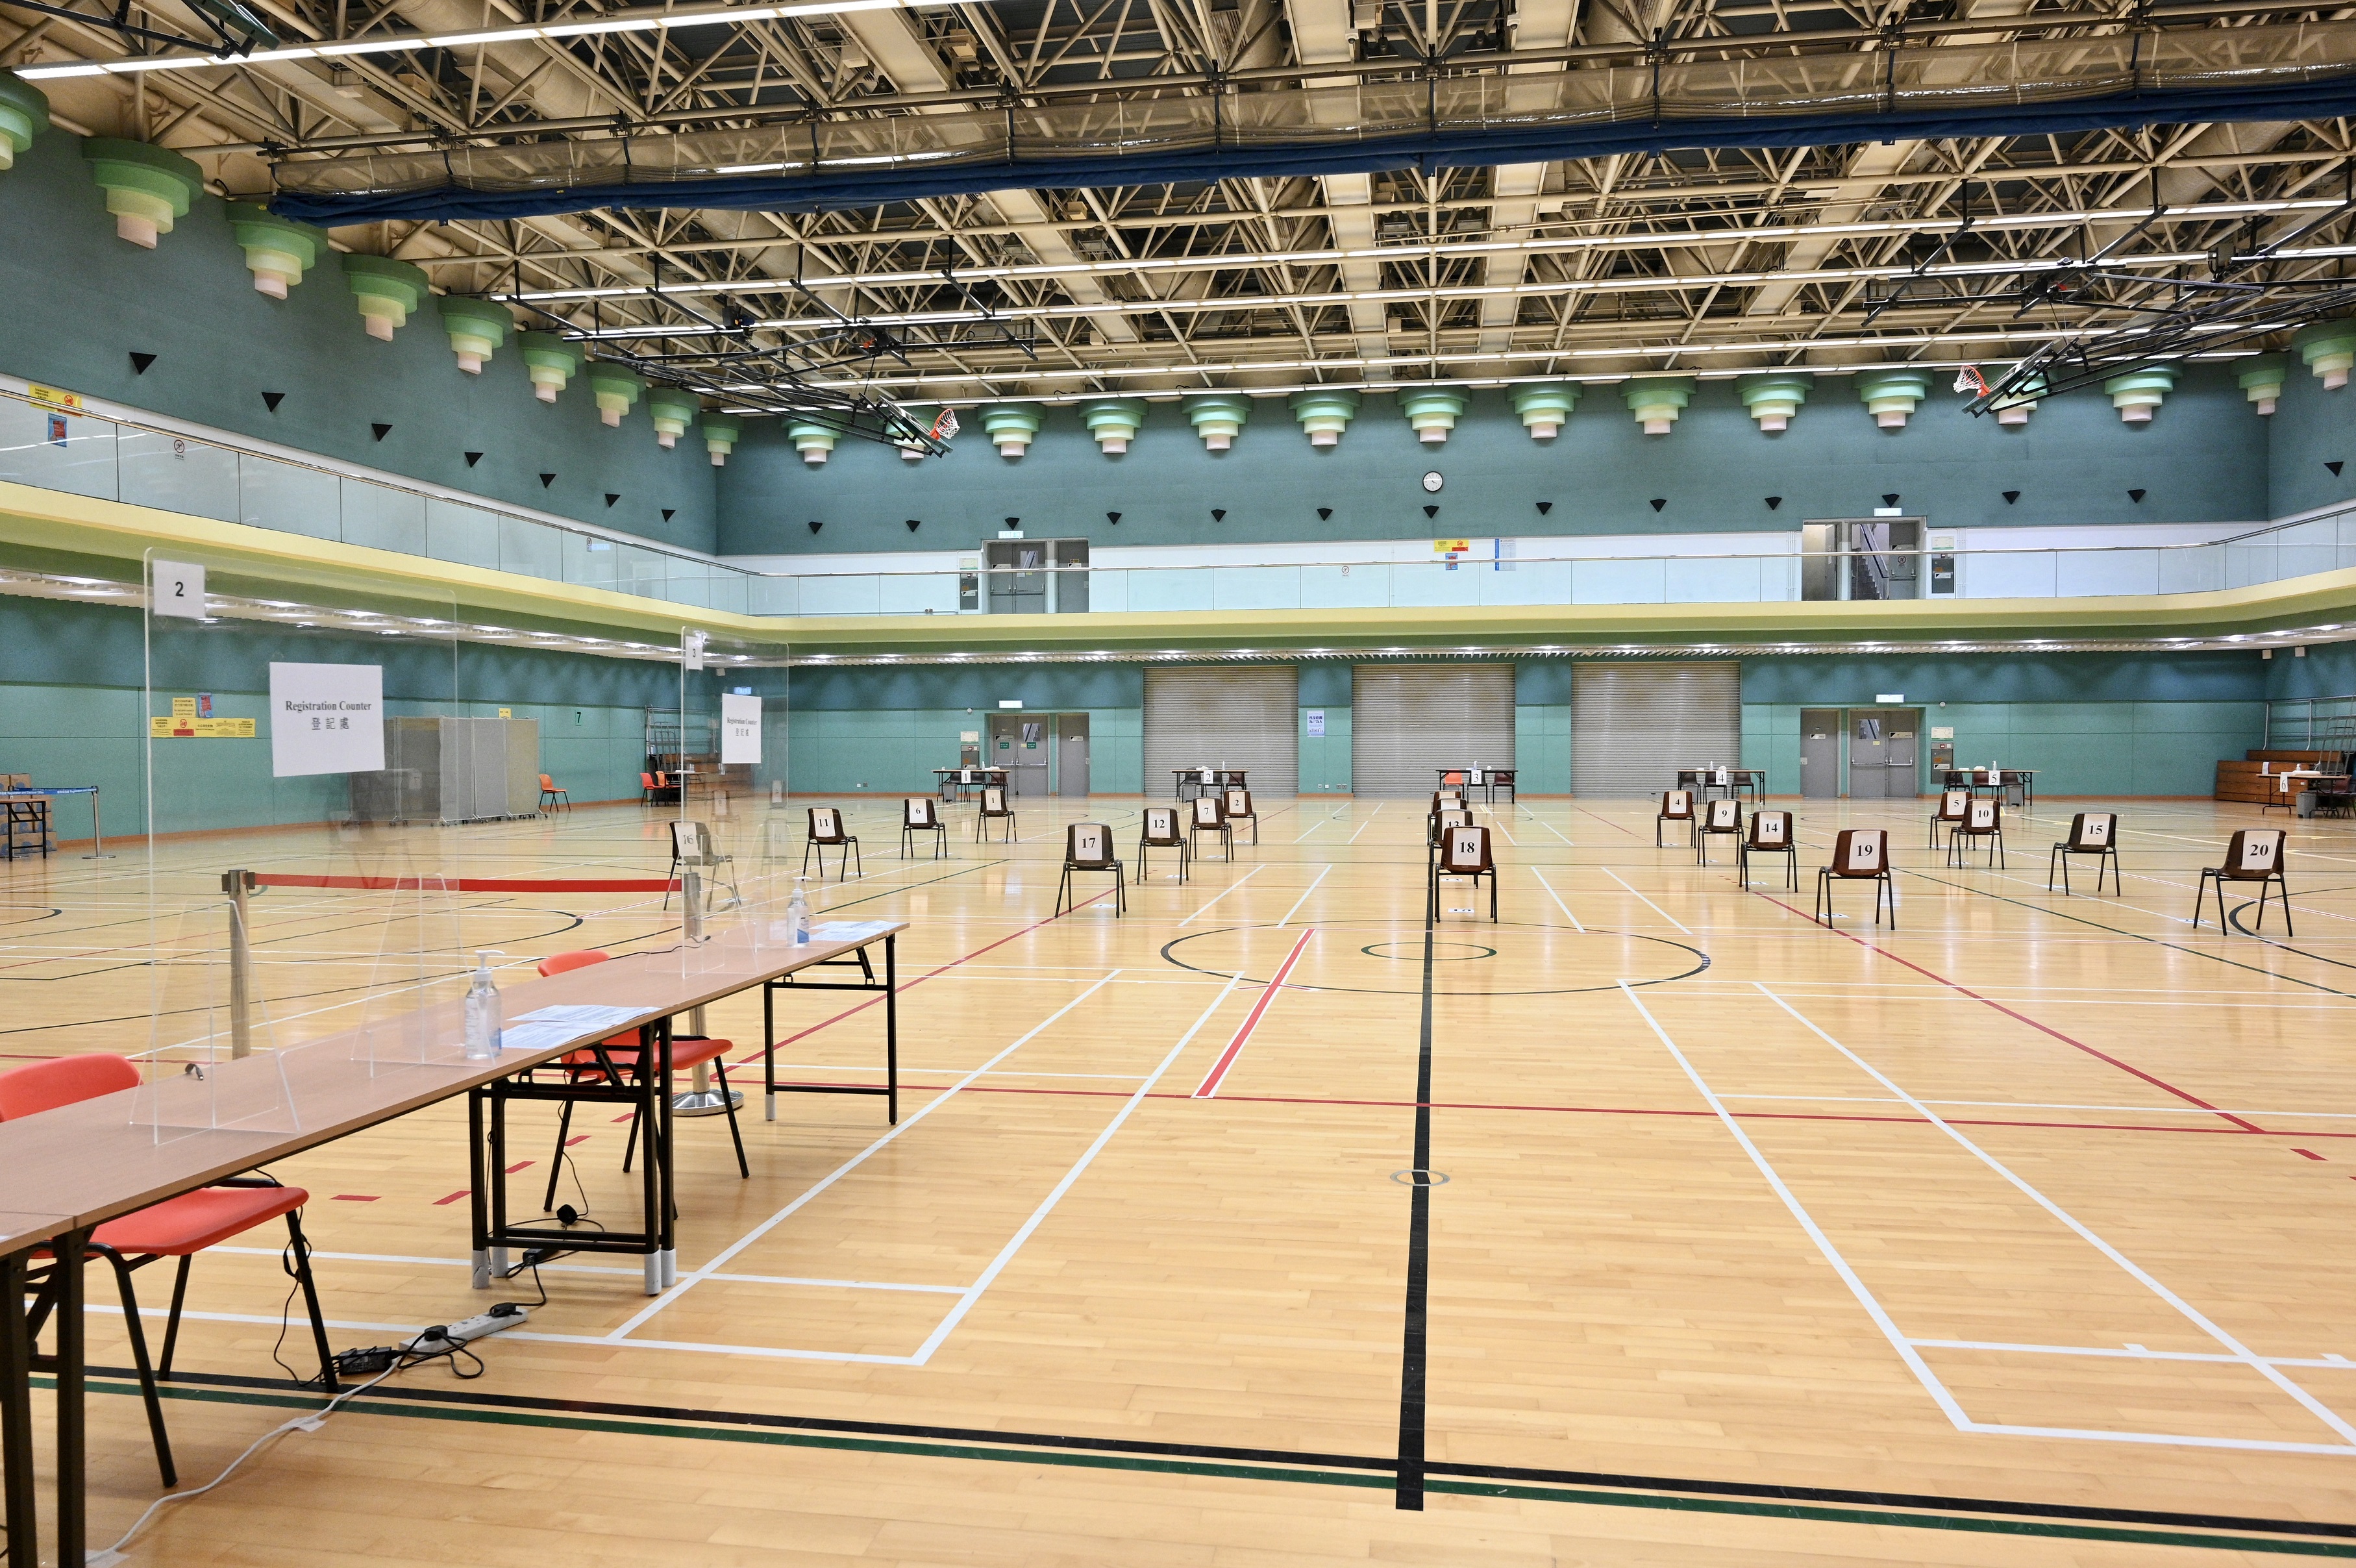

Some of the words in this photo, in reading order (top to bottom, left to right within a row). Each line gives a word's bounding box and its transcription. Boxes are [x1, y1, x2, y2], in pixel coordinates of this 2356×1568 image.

[175, 581, 184, 597] 2
[692, 648, 696, 658] 3
[286, 701, 337, 713] Registration
[339, 701, 372, 711] Counter
[577, 712, 582, 723] 7
[727, 717, 745, 725] Registration
[312, 717, 349, 730] 登記處
[1206, 773, 1211, 782] 2
[1474, 773, 1479, 782] 3
[1718, 774, 1724, 783] 4
[1991, 774, 1997, 784] 5
[2281, 779, 2287, 790] 6
[1978, 810, 1989, 818] 10
[819, 818, 828, 827] 11
[1154, 819, 1165, 828] 12
[1766, 823, 1778, 832] 14
[2089, 825, 2103, 835] 15
[683, 834, 694, 845] 16
[1082, 837, 1096, 849] 17
[1460, 841, 1475, 853] 18
[1857, 844, 1873, 856] 19
[2250, 844, 2269, 856] 20
